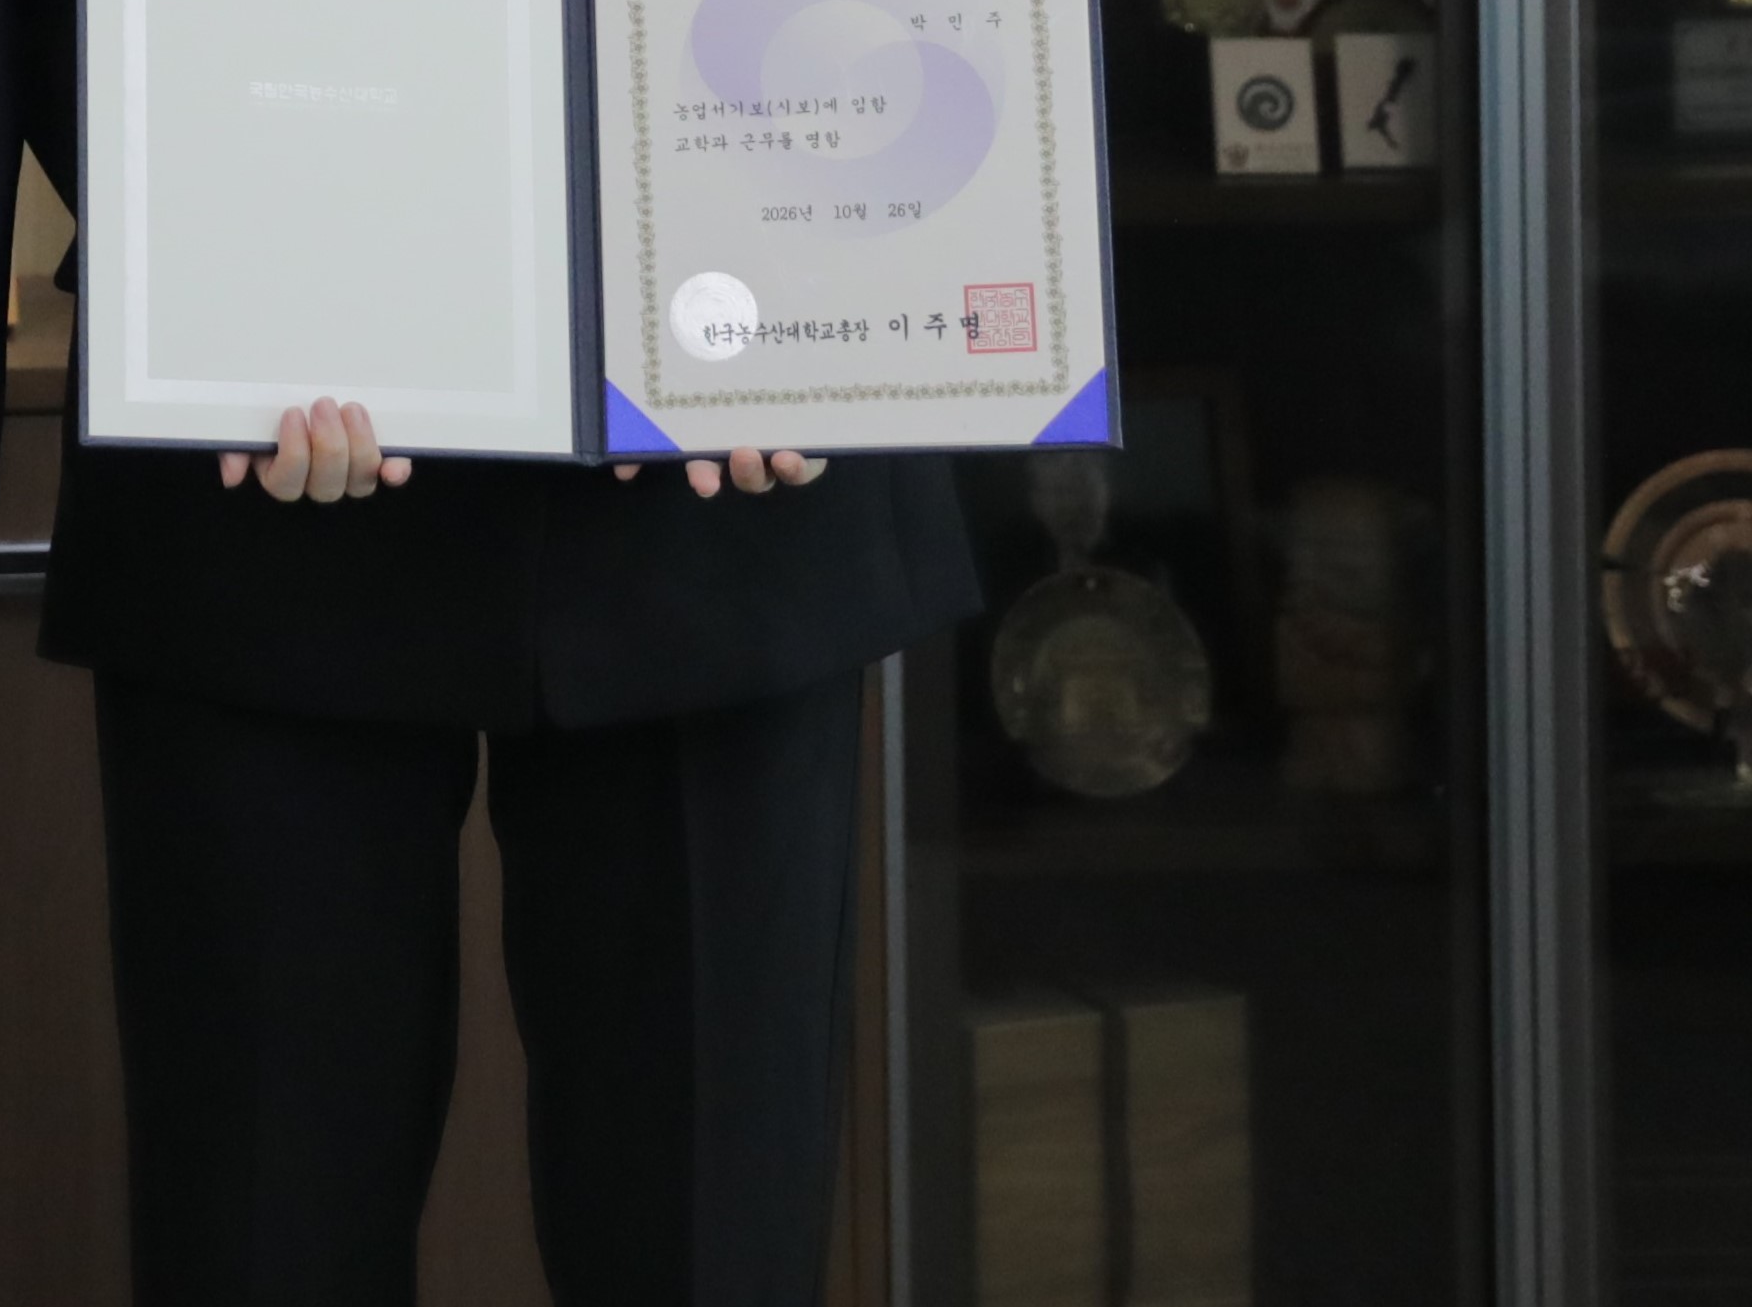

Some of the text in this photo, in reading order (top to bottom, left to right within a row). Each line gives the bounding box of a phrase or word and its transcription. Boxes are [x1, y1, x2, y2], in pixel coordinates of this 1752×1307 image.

[673, 94, 888, 122] 농업서기보(시보)에 임함
[674, 129, 841, 153] 교학과 근무를 명함
[761, 199, 922, 222] 2026년 10월 26일
[702, 318, 870, 347] 한국농수산대학교총장
